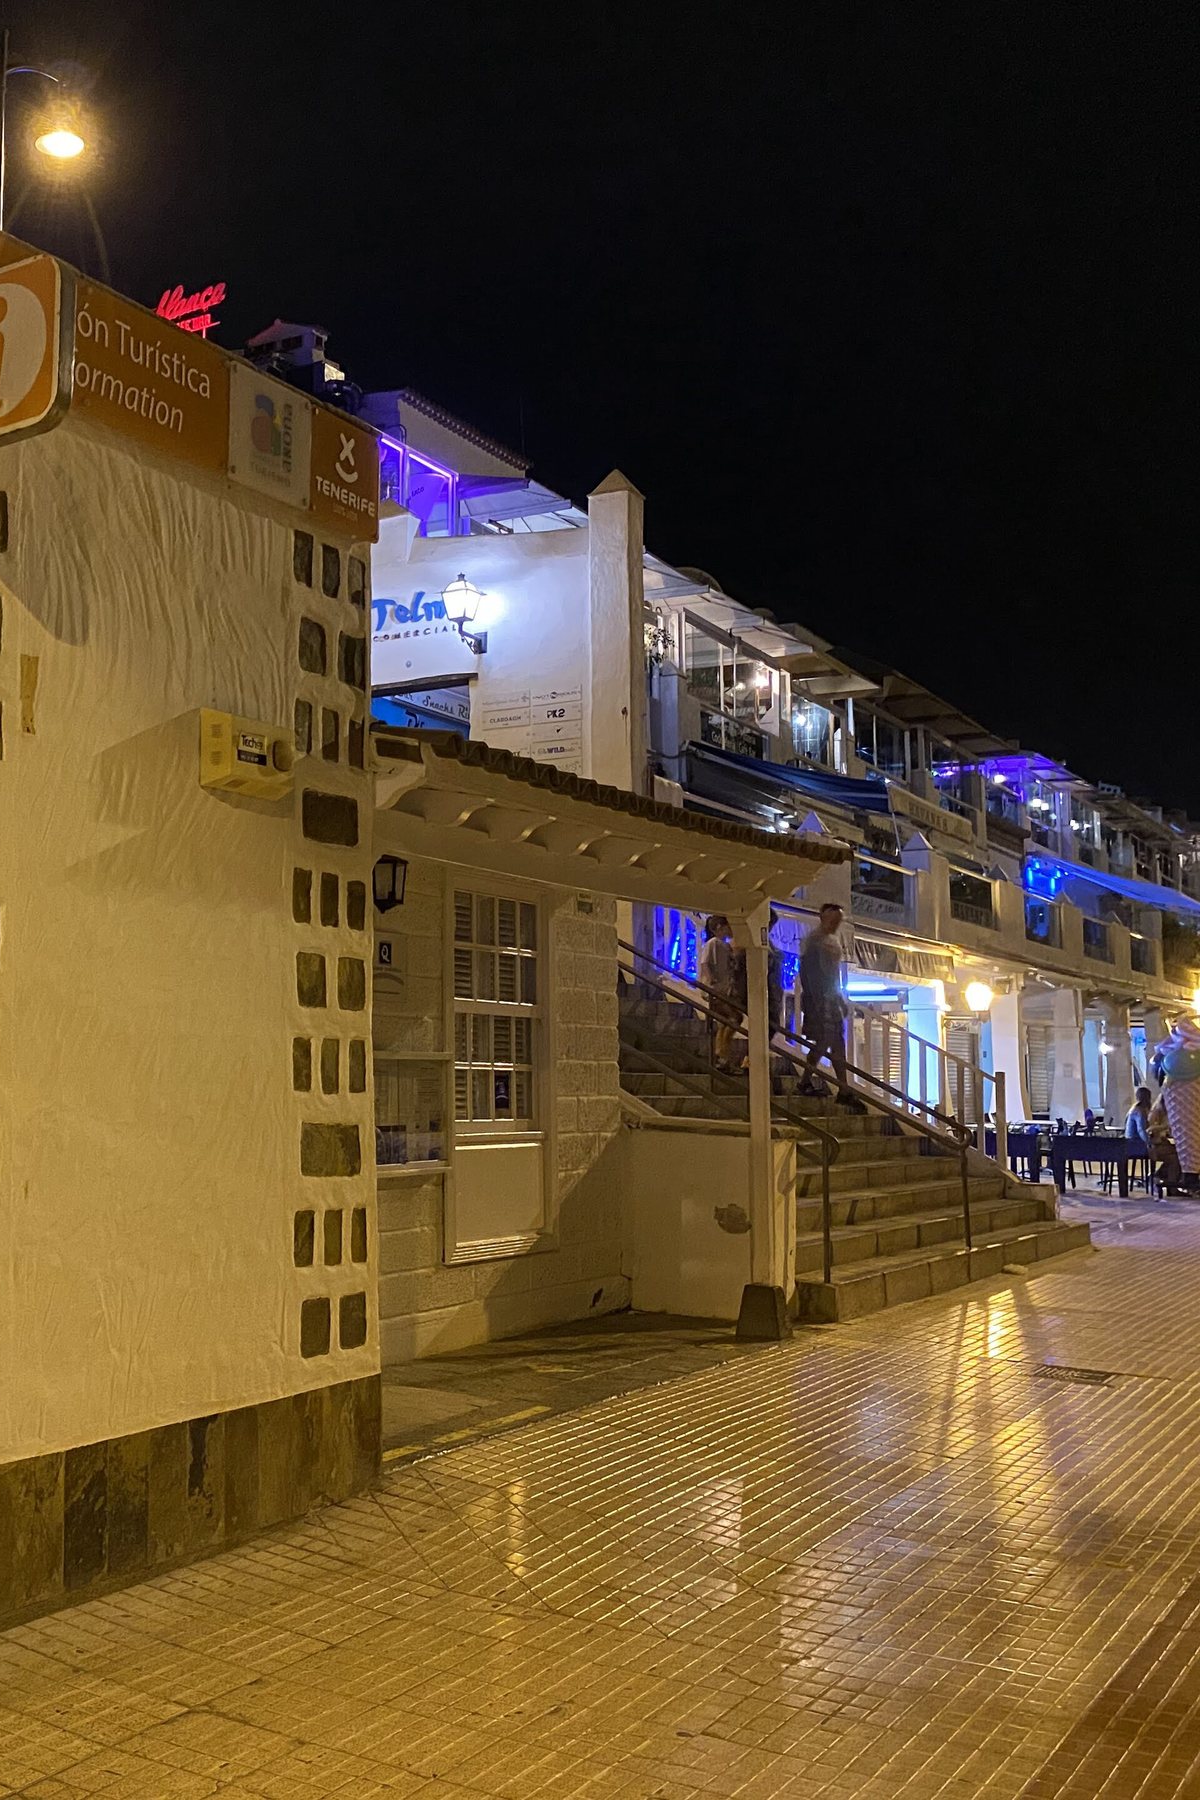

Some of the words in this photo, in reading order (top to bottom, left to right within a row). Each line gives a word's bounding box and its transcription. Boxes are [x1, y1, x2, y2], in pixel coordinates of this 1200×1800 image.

[115, 319, 211, 399] Turística
[75, 361, 184, 433] ormation
[315, 475, 376, 518] TENERIFE
[371, 590, 447, 632] Telm
[373, 624, 457, 643] COMERCIAL
